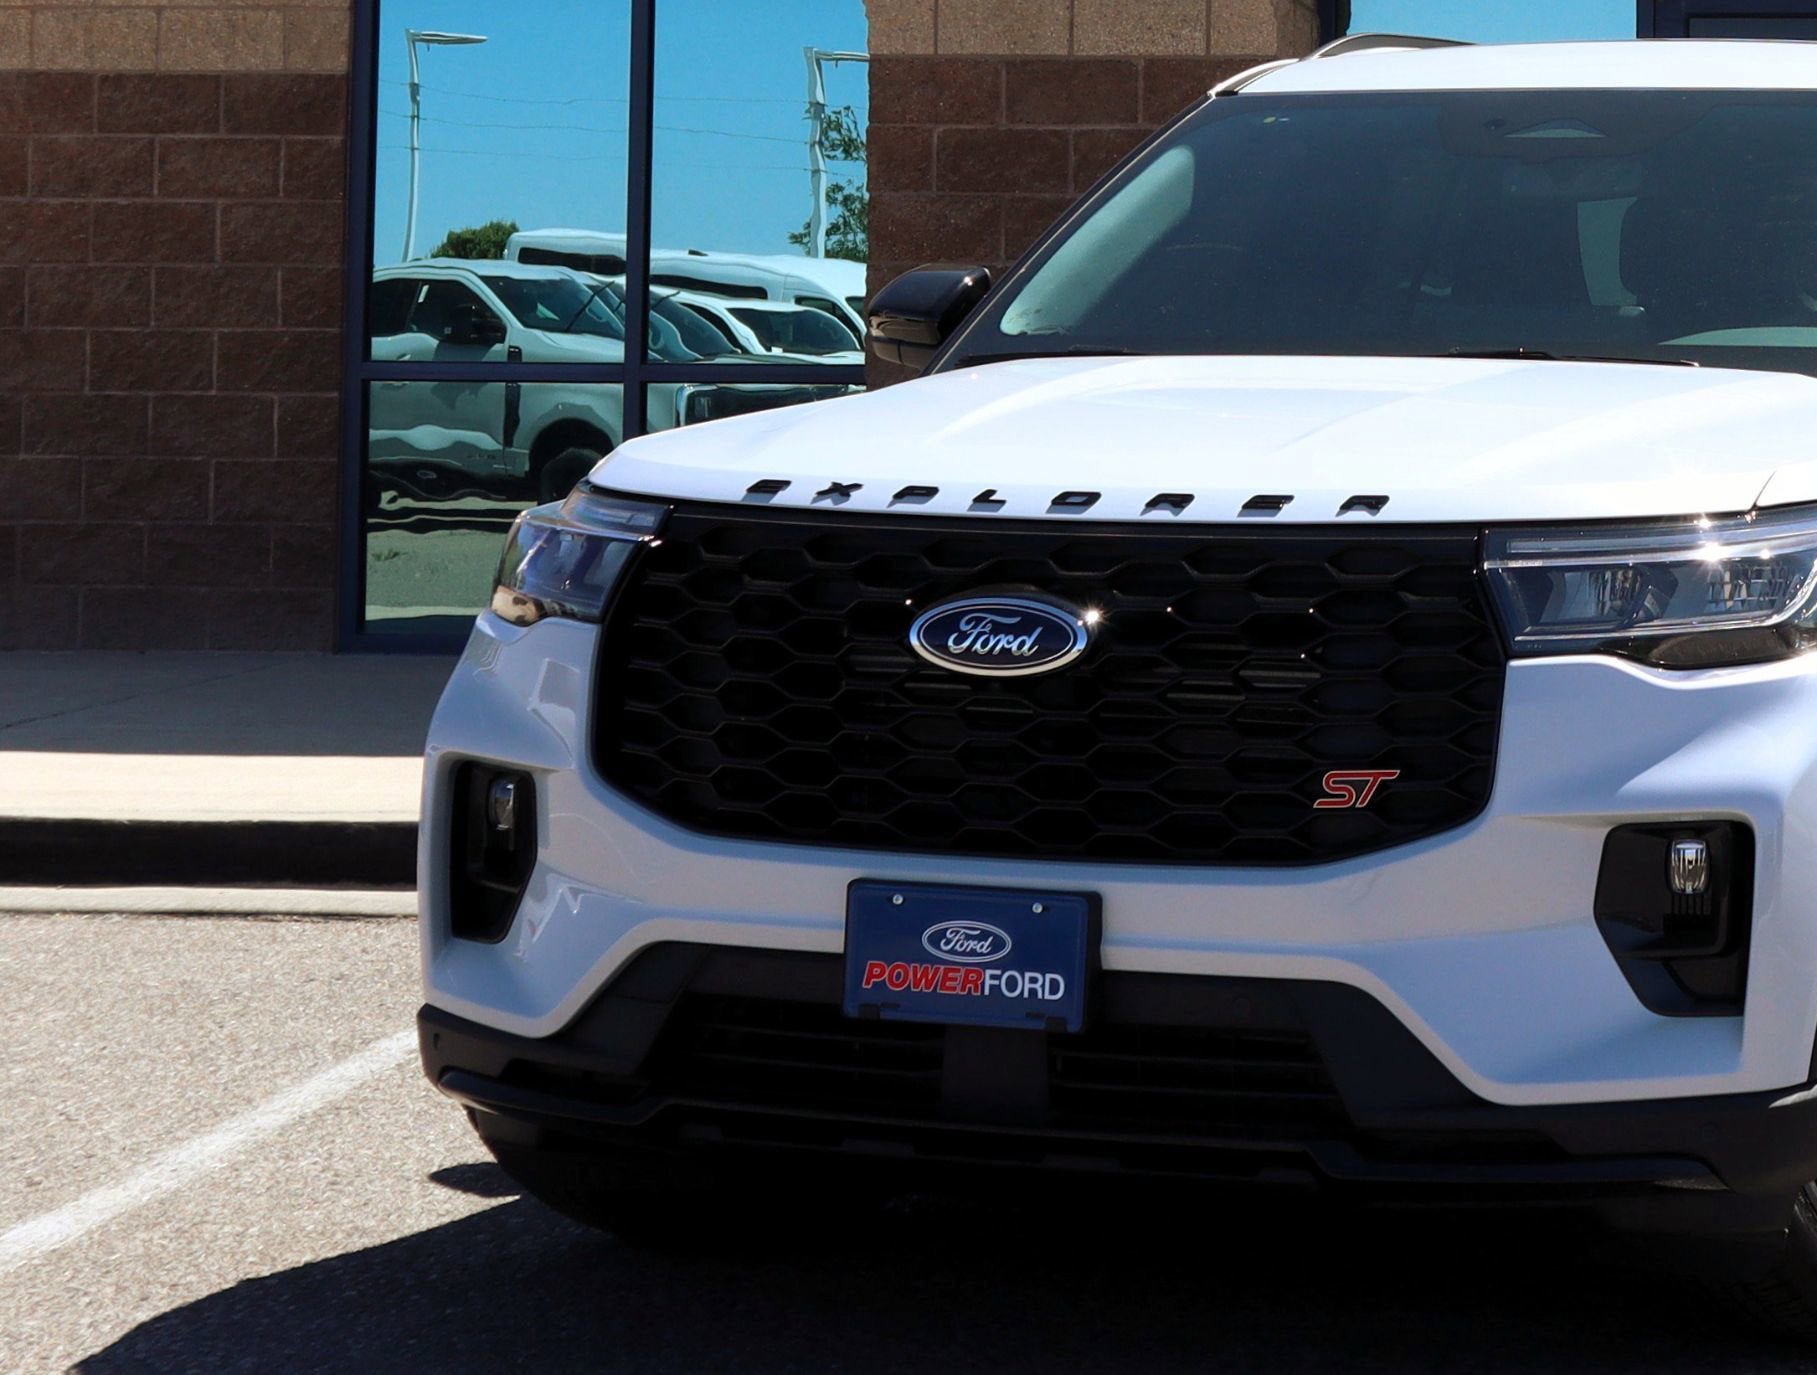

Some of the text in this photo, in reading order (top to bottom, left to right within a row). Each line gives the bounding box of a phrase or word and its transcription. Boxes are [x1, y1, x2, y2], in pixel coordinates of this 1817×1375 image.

[746, 479, 1390, 512] EXPLORER
[947, 613, 1043, 656] Ford
[1312, 769, 1401, 809] ST
[940, 927, 992, 953] Ford
[862, 960, 1066, 1001] POWERFORD
